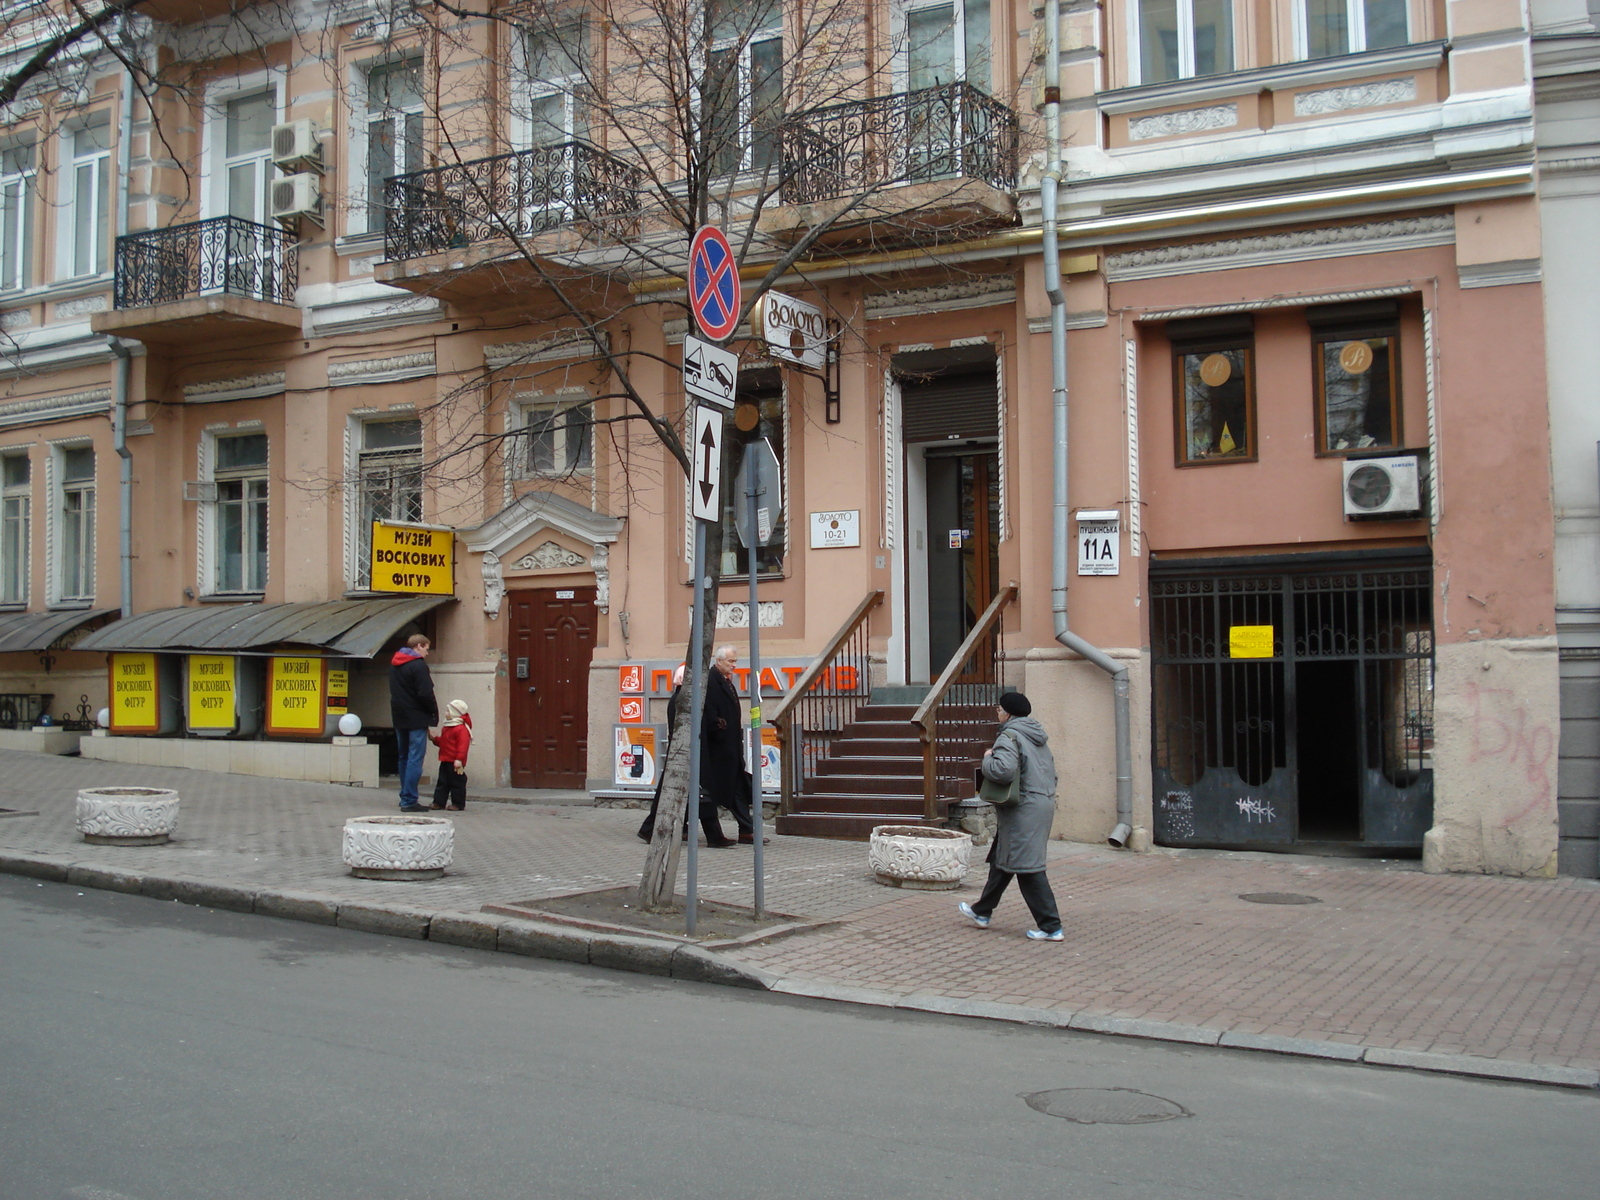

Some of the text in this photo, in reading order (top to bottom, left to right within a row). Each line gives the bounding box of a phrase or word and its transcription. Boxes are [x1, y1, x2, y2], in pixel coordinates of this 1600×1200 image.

[768, 298, 824, 340] ЗОЛОТО
[818, 512, 852, 523] ЗОЛОТО
[824, 530, 846, 539] 10-21
[1080, 526, 1118, 534] ПУШКІНСЬКА
[394, 530, 432, 547] МУЗЕЙ
[376, 549, 446, 567] ВОСКОВИХ
[392, 573, 431, 587] ФІГУР
[122, 662, 146, 675] МУЗЕЙ
[199, 662, 224, 675] МУЗЕЙ
[283, 661, 310, 673] МУЗЕЙ
[652, 666, 860, 692] ПТАТИВ
[116, 681, 152, 692] ВОСКОВИХ
[192, 681, 231, 692] ВОСКОВИХ
[275, 680, 317, 691] ВОСКОВИХ
[124, 697, 145, 708] ФІГУР
[201, 697, 224, 708] ФІГУР
[282, 697, 307, 708] ФІГУР
